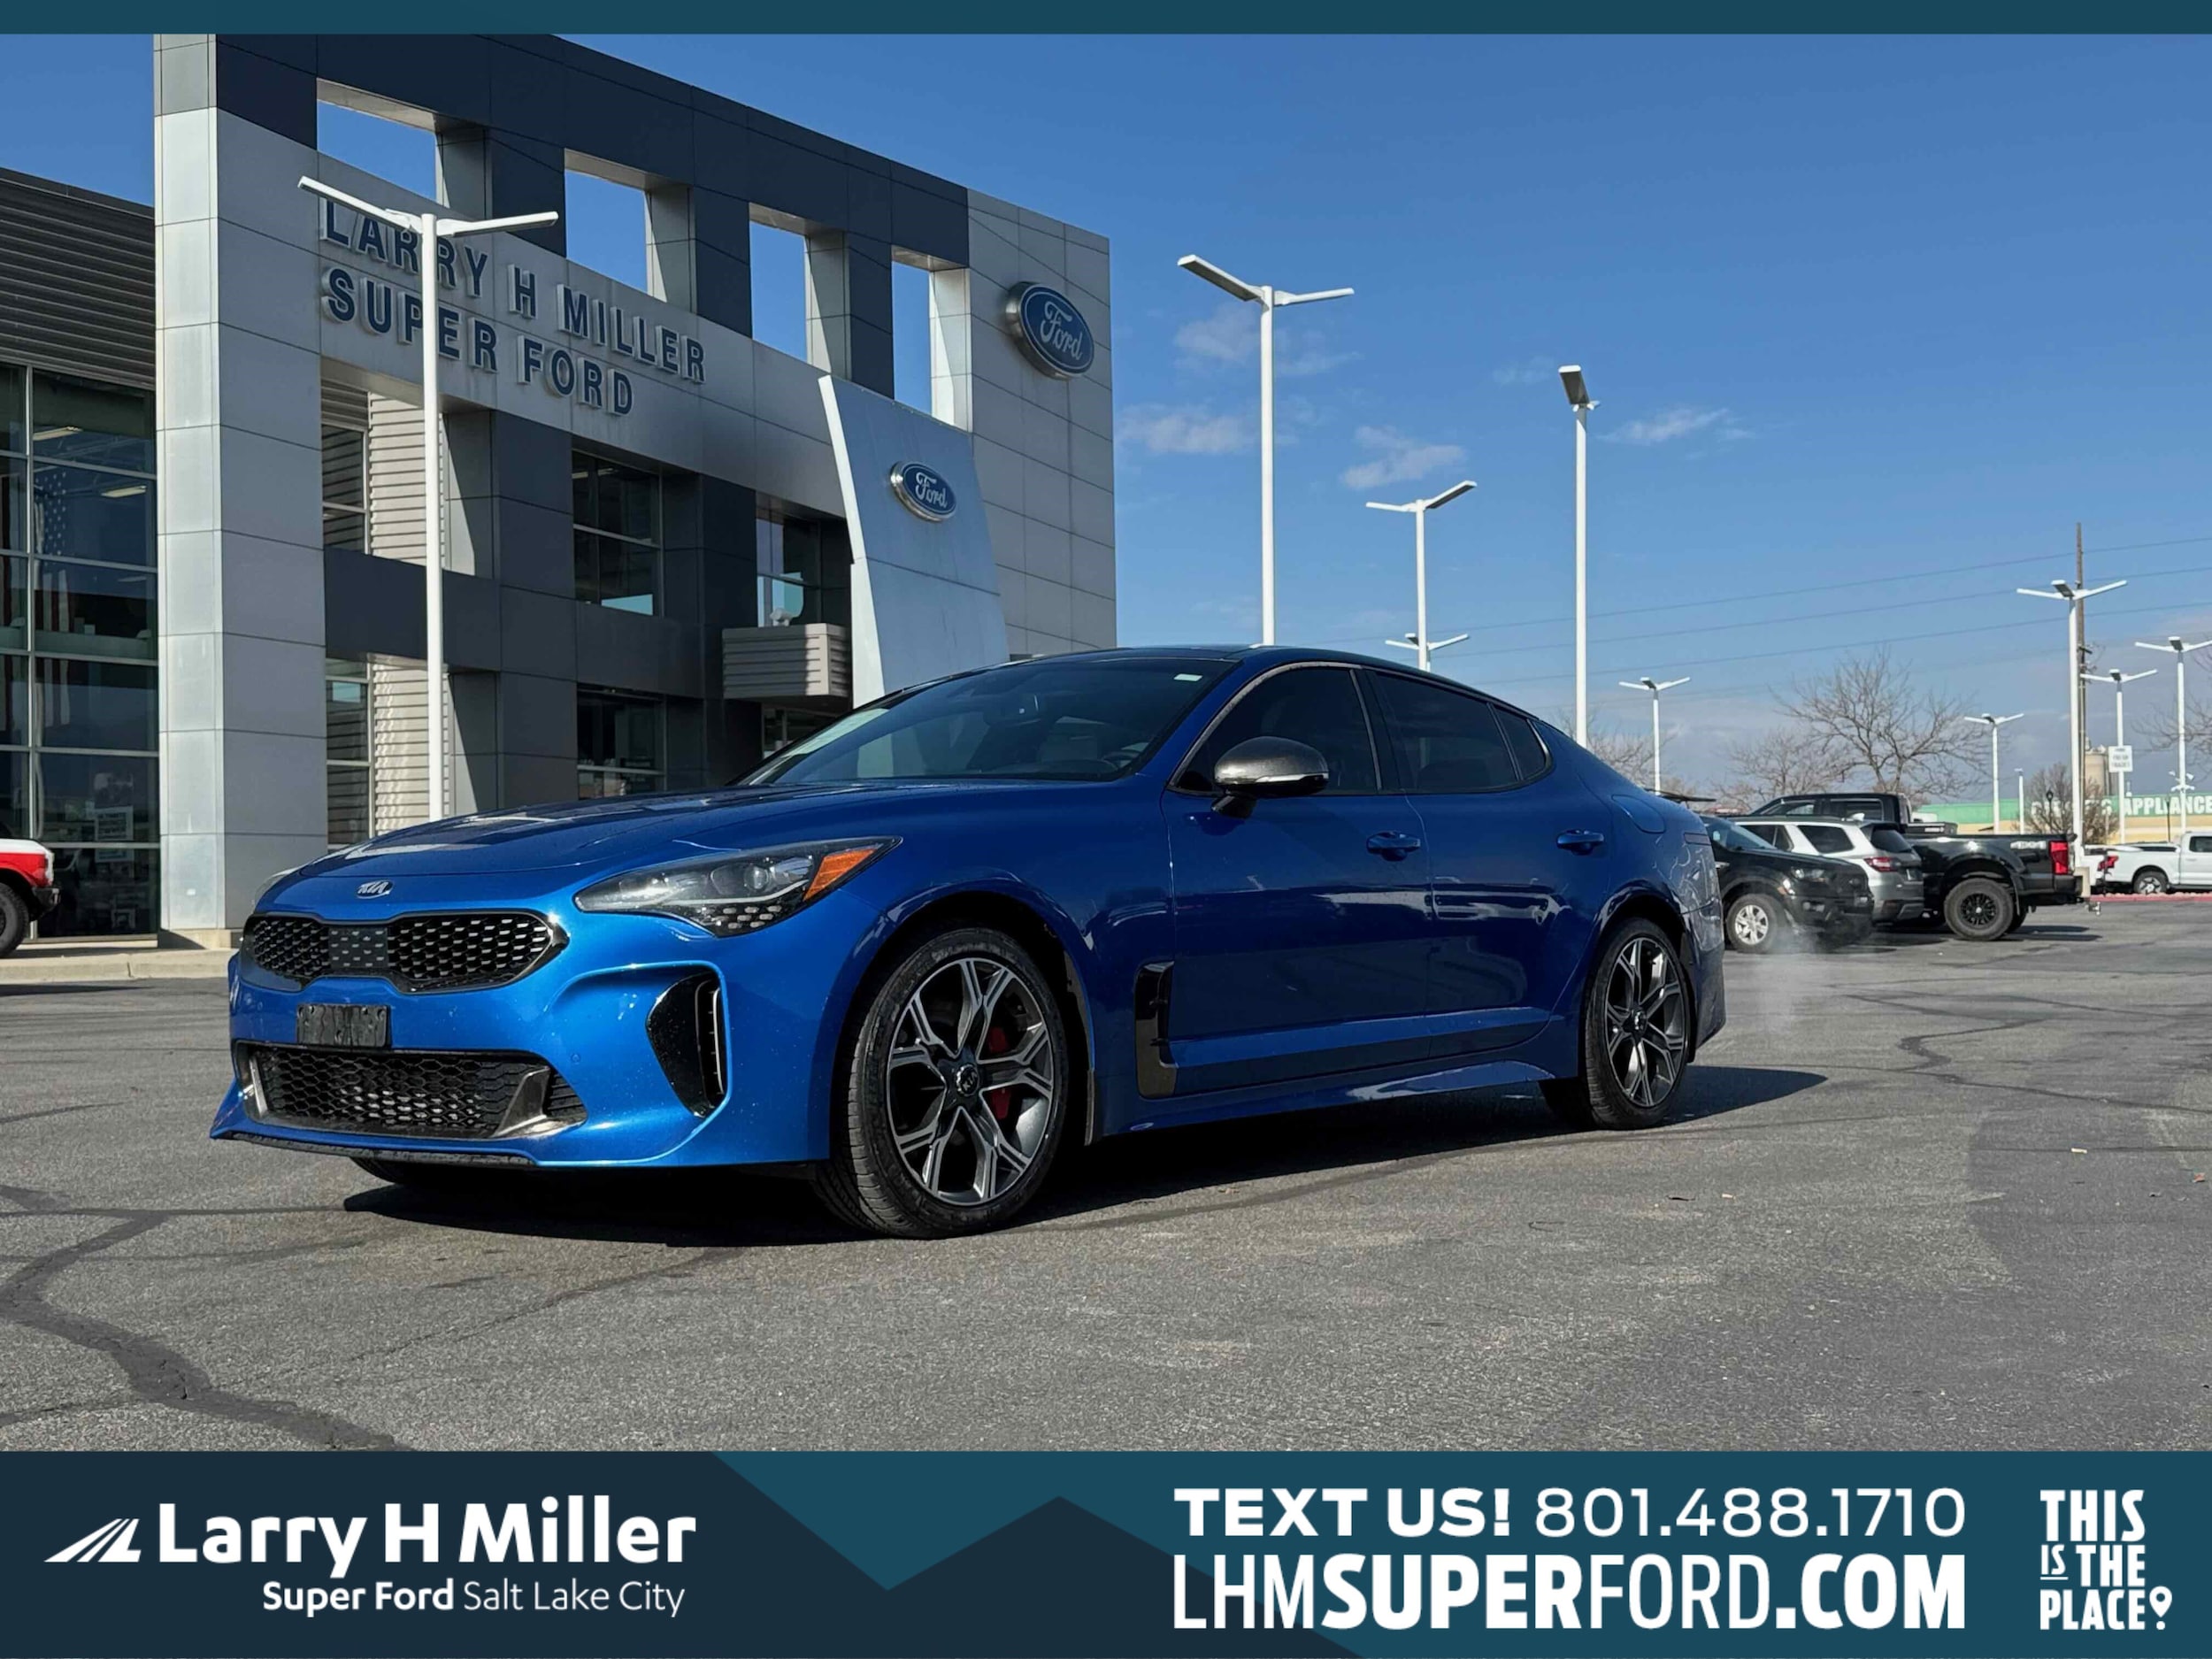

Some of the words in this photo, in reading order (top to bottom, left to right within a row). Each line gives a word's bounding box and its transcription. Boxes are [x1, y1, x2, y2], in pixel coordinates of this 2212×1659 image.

[321, 197, 488, 298] LARRY
[510, 265, 537, 318] H
[558, 284, 705, 383] MILLER
[321, 267, 498, 373] SUPER
[518, 335, 633, 415] FORD
[1040, 301, 1083, 360] Ford
[915, 472, 948, 508] Ford
